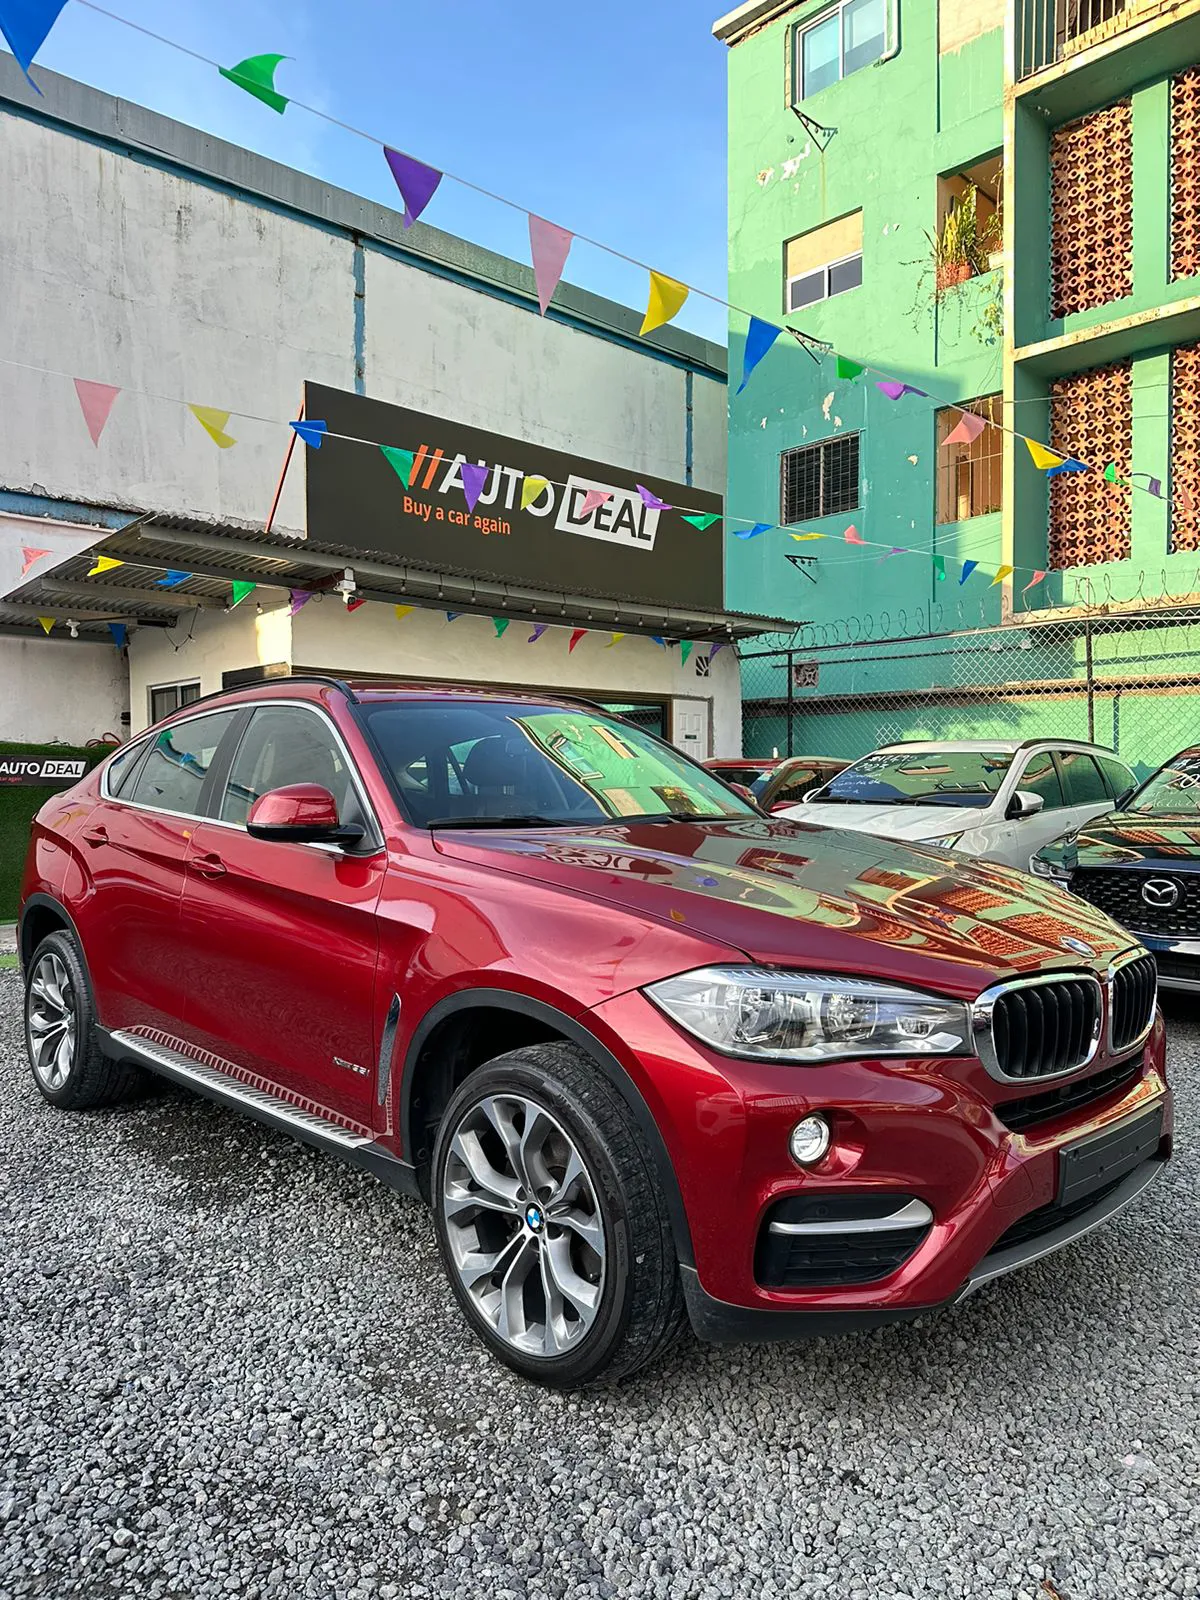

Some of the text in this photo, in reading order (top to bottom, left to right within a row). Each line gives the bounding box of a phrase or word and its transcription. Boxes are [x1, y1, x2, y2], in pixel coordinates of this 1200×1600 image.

[403, 495, 512, 535] Buy a car again
[566, 486, 652, 541] DEAL
[0, 761, 81, 775] AUTO DEAL
